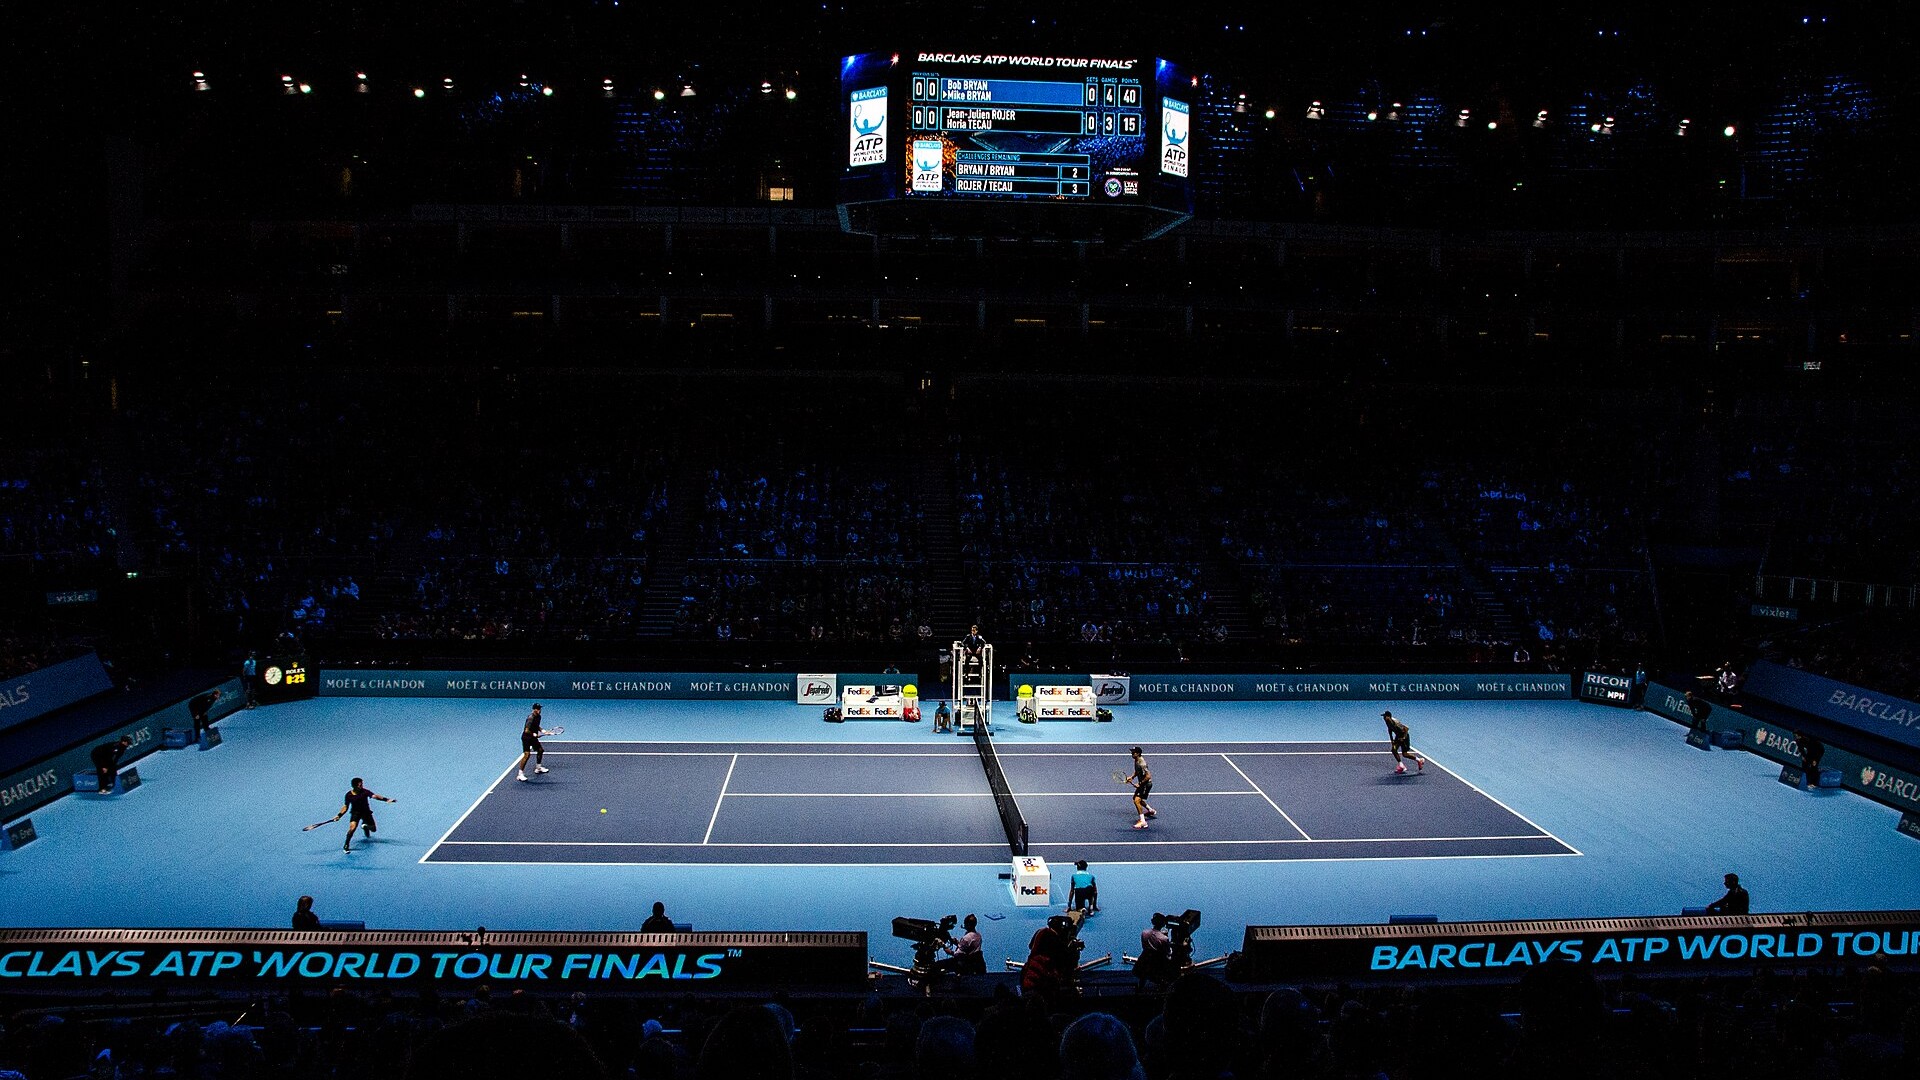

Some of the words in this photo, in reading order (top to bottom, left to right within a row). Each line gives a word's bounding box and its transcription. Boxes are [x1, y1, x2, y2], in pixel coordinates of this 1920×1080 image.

[918, 53, 981, 64] BARCLAYS
[983, 55, 1007, 65] ATP
[1009, 56, 1054, 66] WORLD
[1056, 58, 1088, 68] TOUR
[915, 81, 922, 96] 0
[929, 82, 935, 96] 0
[947, 80, 961, 90] Bob
[963, 81, 988, 91] BRYAN
[947, 90, 965, 100] Mike
[966, 91, 991, 101] BRYAN
[1089, 88, 1095, 102] 0
[1106, 88, 1113, 102] 4
[1123, 89, 1136, 103] 40
[915, 110, 922, 124] 0
[929, 111, 935, 125] 0
[947, 109, 990, 120] Jean-Julien
[992, 110, 1016, 120] ROJER
[947, 119, 966, 129] Horia
[968, 120, 992, 130] TECAU
[1088, 116, 1095, 130] 0
[1106, 117, 1112, 131] 3
[1123, 117, 1136, 132] 15
[854, 138, 883, 152] ATP
[958, 152, 990, 160] CHALLENGES
[1164, 148, 1186, 161] ATP
[958, 164, 983, 176] BRYAN
[989, 165, 1015, 176] BRYAN
[1072, 168, 1078, 178] 2
[916, 173, 939, 181] ATP
[958, 180, 983, 191] ROJER
[988, 181, 1013, 192] TECAU
[1072, 184, 1078, 194] 3
[360, 681, 367, 689] &
[369, 679, 425, 689] CHANDON
[480, 682, 487, 690] &
[489, 680, 546, 690] CHANDON
[605, 683, 612, 691] &
[615, 682, 672, 691] CHANDON
[1587, 674, 1630, 688] RICOH
[724, 684, 731, 692] &
[733, 683, 790, 692] CHANDON
[848, 688, 871, 696] FedEx
[1040, 688, 1062, 696] FedEx
[1180, 684, 1234, 693] CHANDON
[1288, 685, 1295, 693] &
[1296, 683, 1349, 692] CHANDON
[1408, 683, 1460, 692] CHANDON
[1515, 683, 1566, 692] CHANDON
[1588, 686, 1606, 697] 112
[1607, 690, 1625, 700] MPH
[848, 708, 871, 716] FedEx
[875, 708, 898, 716] FedEx
[1041, 708, 1064, 716] FedEx
[1068, 708, 1091, 716] FedEx
[1828, 690, 1920, 730] BARCLAY
[1, 769, 58, 806] BARCLAYS
[1875, 772, 1920, 802] BARCL
[1021, 886, 1047, 896] FedEx
[1371, 939, 1583, 970] BARCLAYS
[1592, 937, 1669, 964] ATP
[1678, 933, 1822, 960] WORLD
[0, 950, 145, 978] CLAYS
[150, 950, 243, 978] ATP
[253, 951, 421, 979] WORLD
[431, 952, 553, 980] TOUR
